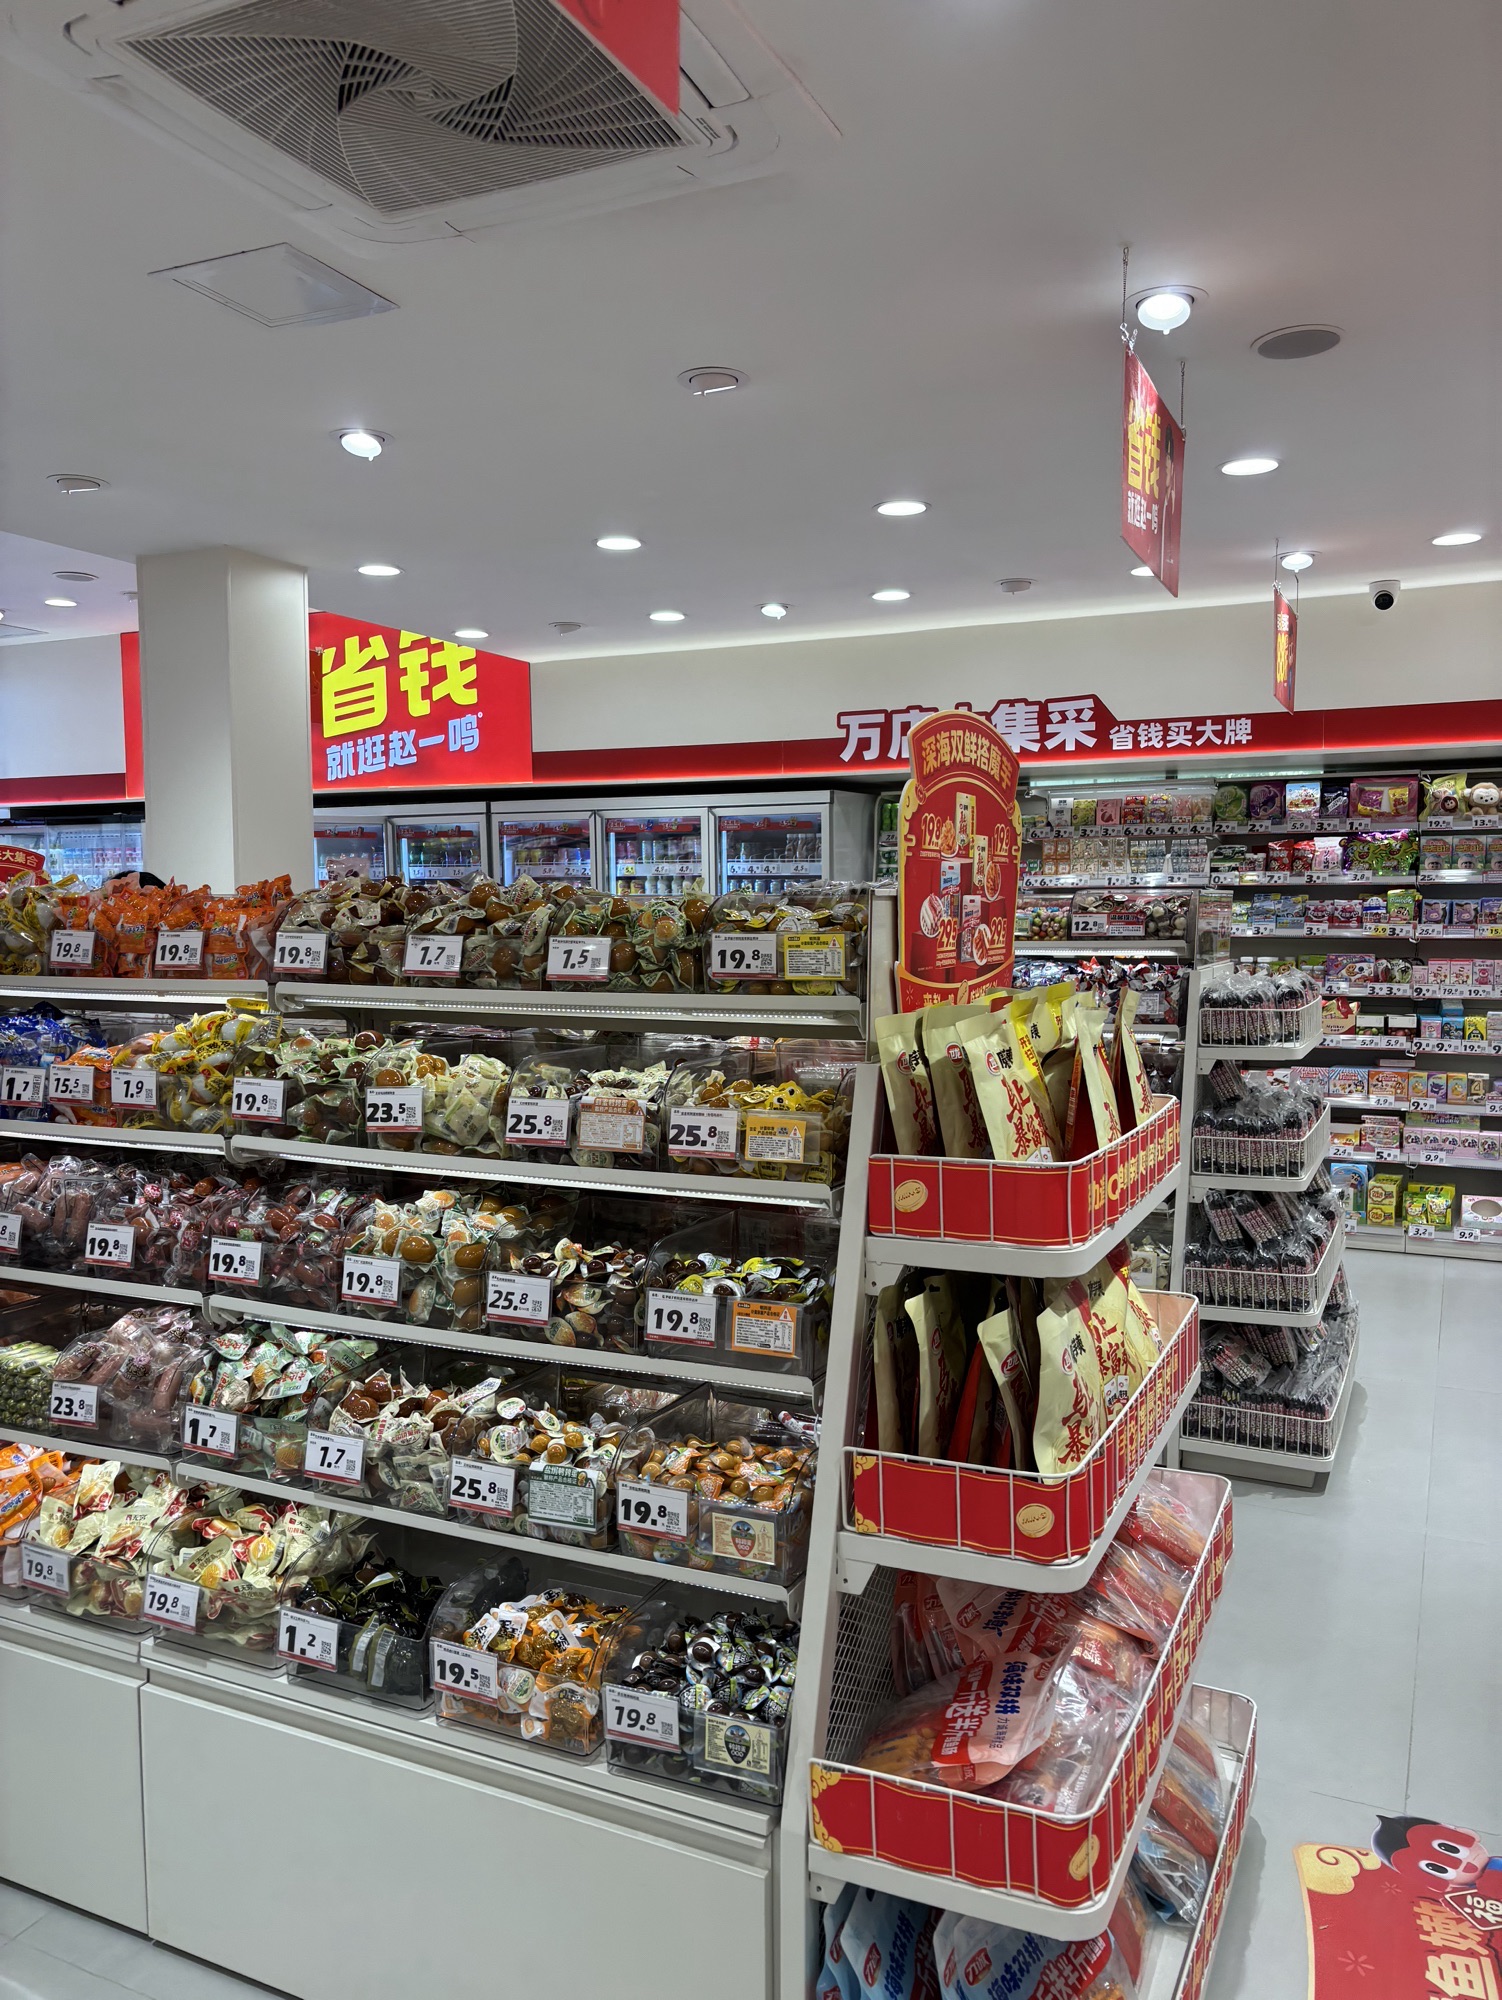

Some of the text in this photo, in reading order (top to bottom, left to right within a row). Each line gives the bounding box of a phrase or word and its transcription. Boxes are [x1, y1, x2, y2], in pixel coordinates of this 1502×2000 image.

[321, 629, 479, 736] 省钱
[839, 697, 1097, 763] 万集采
[1109, 718, 1253, 750] 省钱买大牌
[326, 712, 480, 781] 就逛赵一鸣
[921, 729, 1013, 790] 深海双鲜搭魔芋
[1080, 828, 1093, 837] 3.9
[1102, 828, 1115, 836] 3.9
[1124, 827, 1137, 835] 6.5
[1145, 827, 1159, 835] 6.5
[1190, 825, 1204, 834] 4.9
[1215, 824, 1229, 832] 2.9
[1249, 824, 1263, 832] 2.9
[1316, 822, 1331, 831] 3.9
[1074, 921, 1097, 931] 12.8
[1306, 927, 1320, 935] 3.5
[56, 942, 80, 958] 19.8
[160, 944, 190, 961] 19.8
[279, 946, 312, 964] 19.8
[420, 946, 446, 965] 1.7
[562, 949, 590, 969] 1.5
[718, 949, 760, 969] 19.8
[1386, 987, 1400, 995] 3.9
[1414, 987, 1430, 996] 9.9
[6, 1077, 30, 1101] 1.7
[54, 1077, 80, 1094] 15.5
[123, 1080, 144, 1098] 1.9
[234, 1093, 268, 1112] 19.8
[366, 1103, 406, 1123] 23.5
[508, 1113, 552, 1134] 25.8
[669, 1124, 718, 1148] 25.8
[1413, 1228, 1427, 1236] 3.2
[88, 1238, 120, 1257] 19.8
[212, 1252, 246, 1274] 19.8
[346, 1271, 383, 1294] 19.8
[488, 1290, 529, 1311] 25.8
[654, 1308, 698, 1332] 19.8
[52, 1396, 85, 1417] 23.8
[188, 1418, 217, 1446] 1.7
[319, 1446, 346, 1468] 1.7
[451, 1476, 497, 1502] 25.8
[621, 1498, 667, 1526] 19.8
[26, 1559, 53, 1580] 19.8
[148, 1591, 180, 1614] 19.8
[285, 1624, 317, 1656] 1.2
[436, 1659, 479, 1688] 19.5
[995, 1661, 1027, 1715] 海味双拼
[614, 1706, 657, 1731] 19.8
[966, 1952, 990, 1982] 力诚
